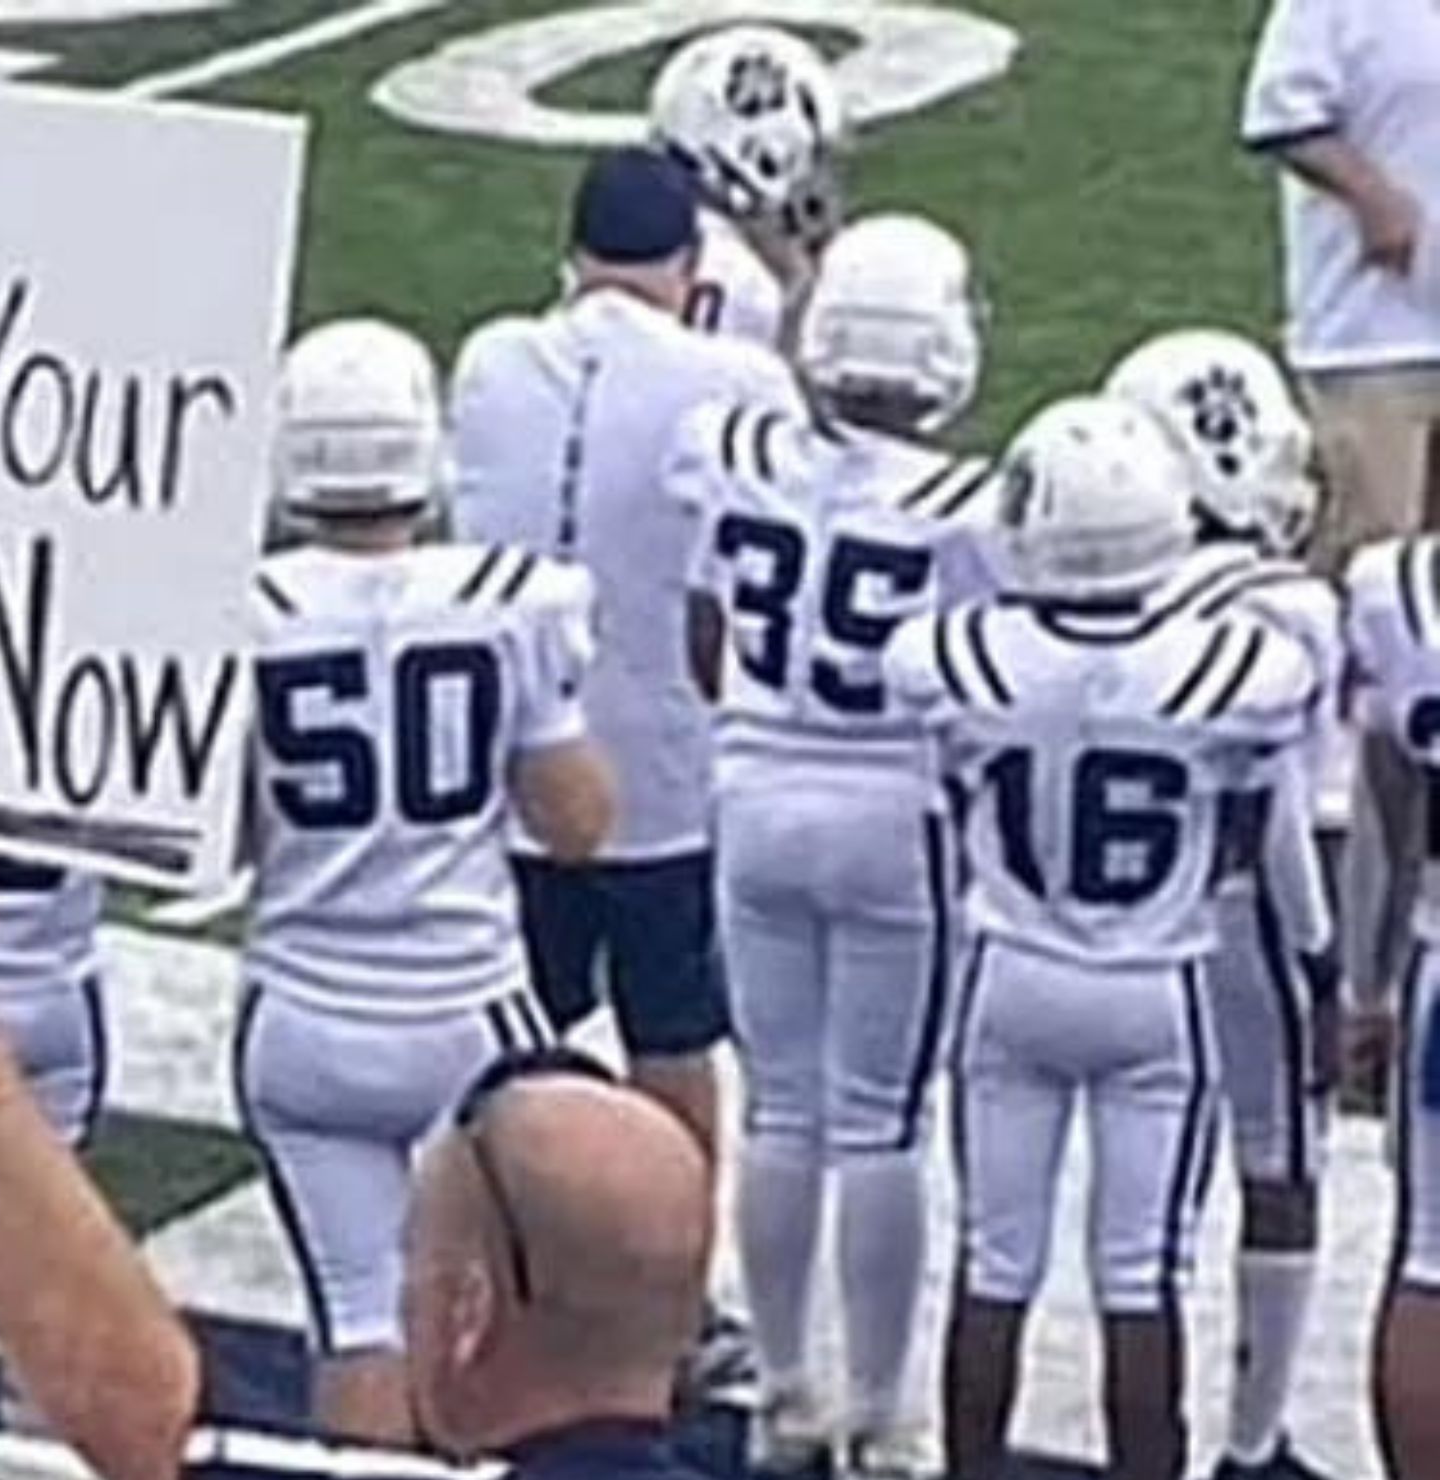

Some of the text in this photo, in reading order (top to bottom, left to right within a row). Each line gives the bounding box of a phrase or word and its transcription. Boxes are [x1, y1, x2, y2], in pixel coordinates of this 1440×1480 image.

[715, 512, 933, 714] 35
[253, 644, 500, 831] 50
[984, 746, 1190, 907] 16
